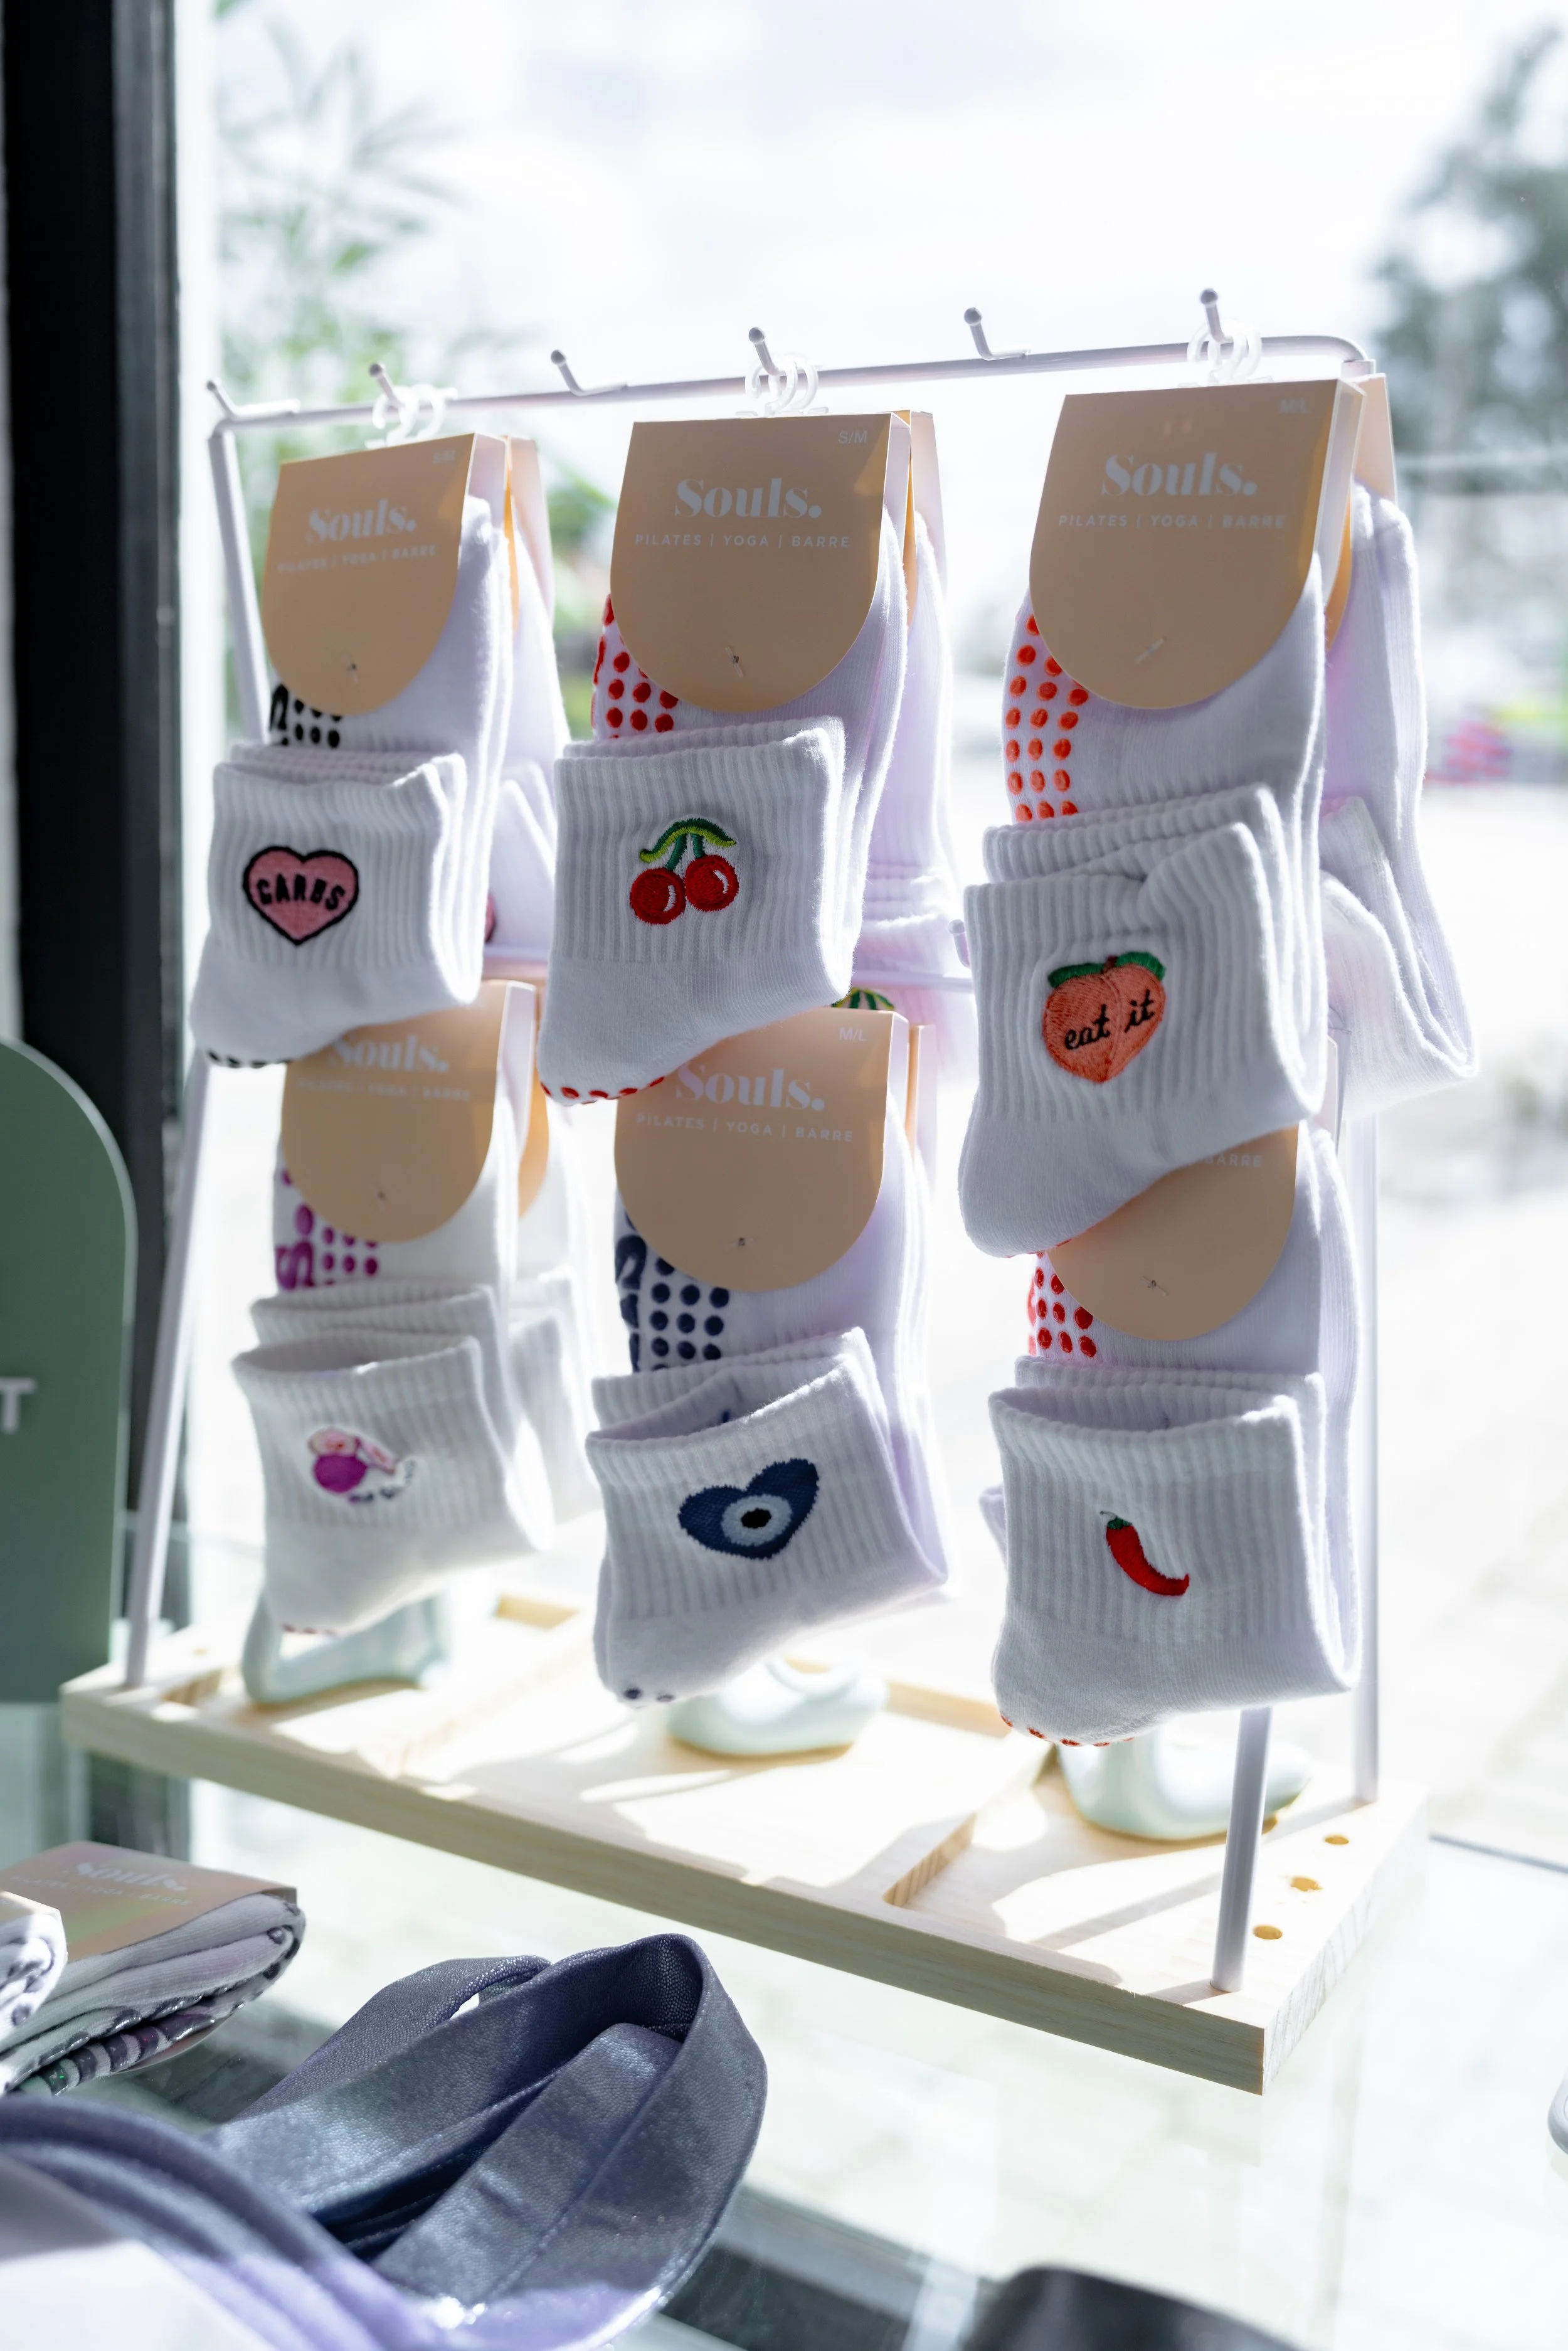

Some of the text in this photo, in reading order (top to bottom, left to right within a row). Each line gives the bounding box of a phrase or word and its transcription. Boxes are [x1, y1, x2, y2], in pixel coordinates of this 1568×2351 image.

[838, 430, 868, 444] S/M
[1100, 452, 1258, 497] Souls.
[674, 477, 823, 519] Souls.
[307, 498, 418, 544] Souls.
[1058, 514, 1128, 527] PILATES
[1150, 514, 1199, 528] YOGA
[1221, 514, 1286, 529] BARRE
[634, 534, 702, 546] PILATES
[723, 534, 770, 547] YOGA
[791, 535, 850, 548] BARRE
[257, 873, 346, 911] CARBS
[839, 1027, 868, 1042] M/L
[1064, 988, 1155, 1050] eat it
[675, 1064, 825, 1112] Souls.
[636, 1112, 705, 1130] PILATES
[726, 1120, 773, 1136] YOGA
[795, 1127, 854, 1143] BARRE
